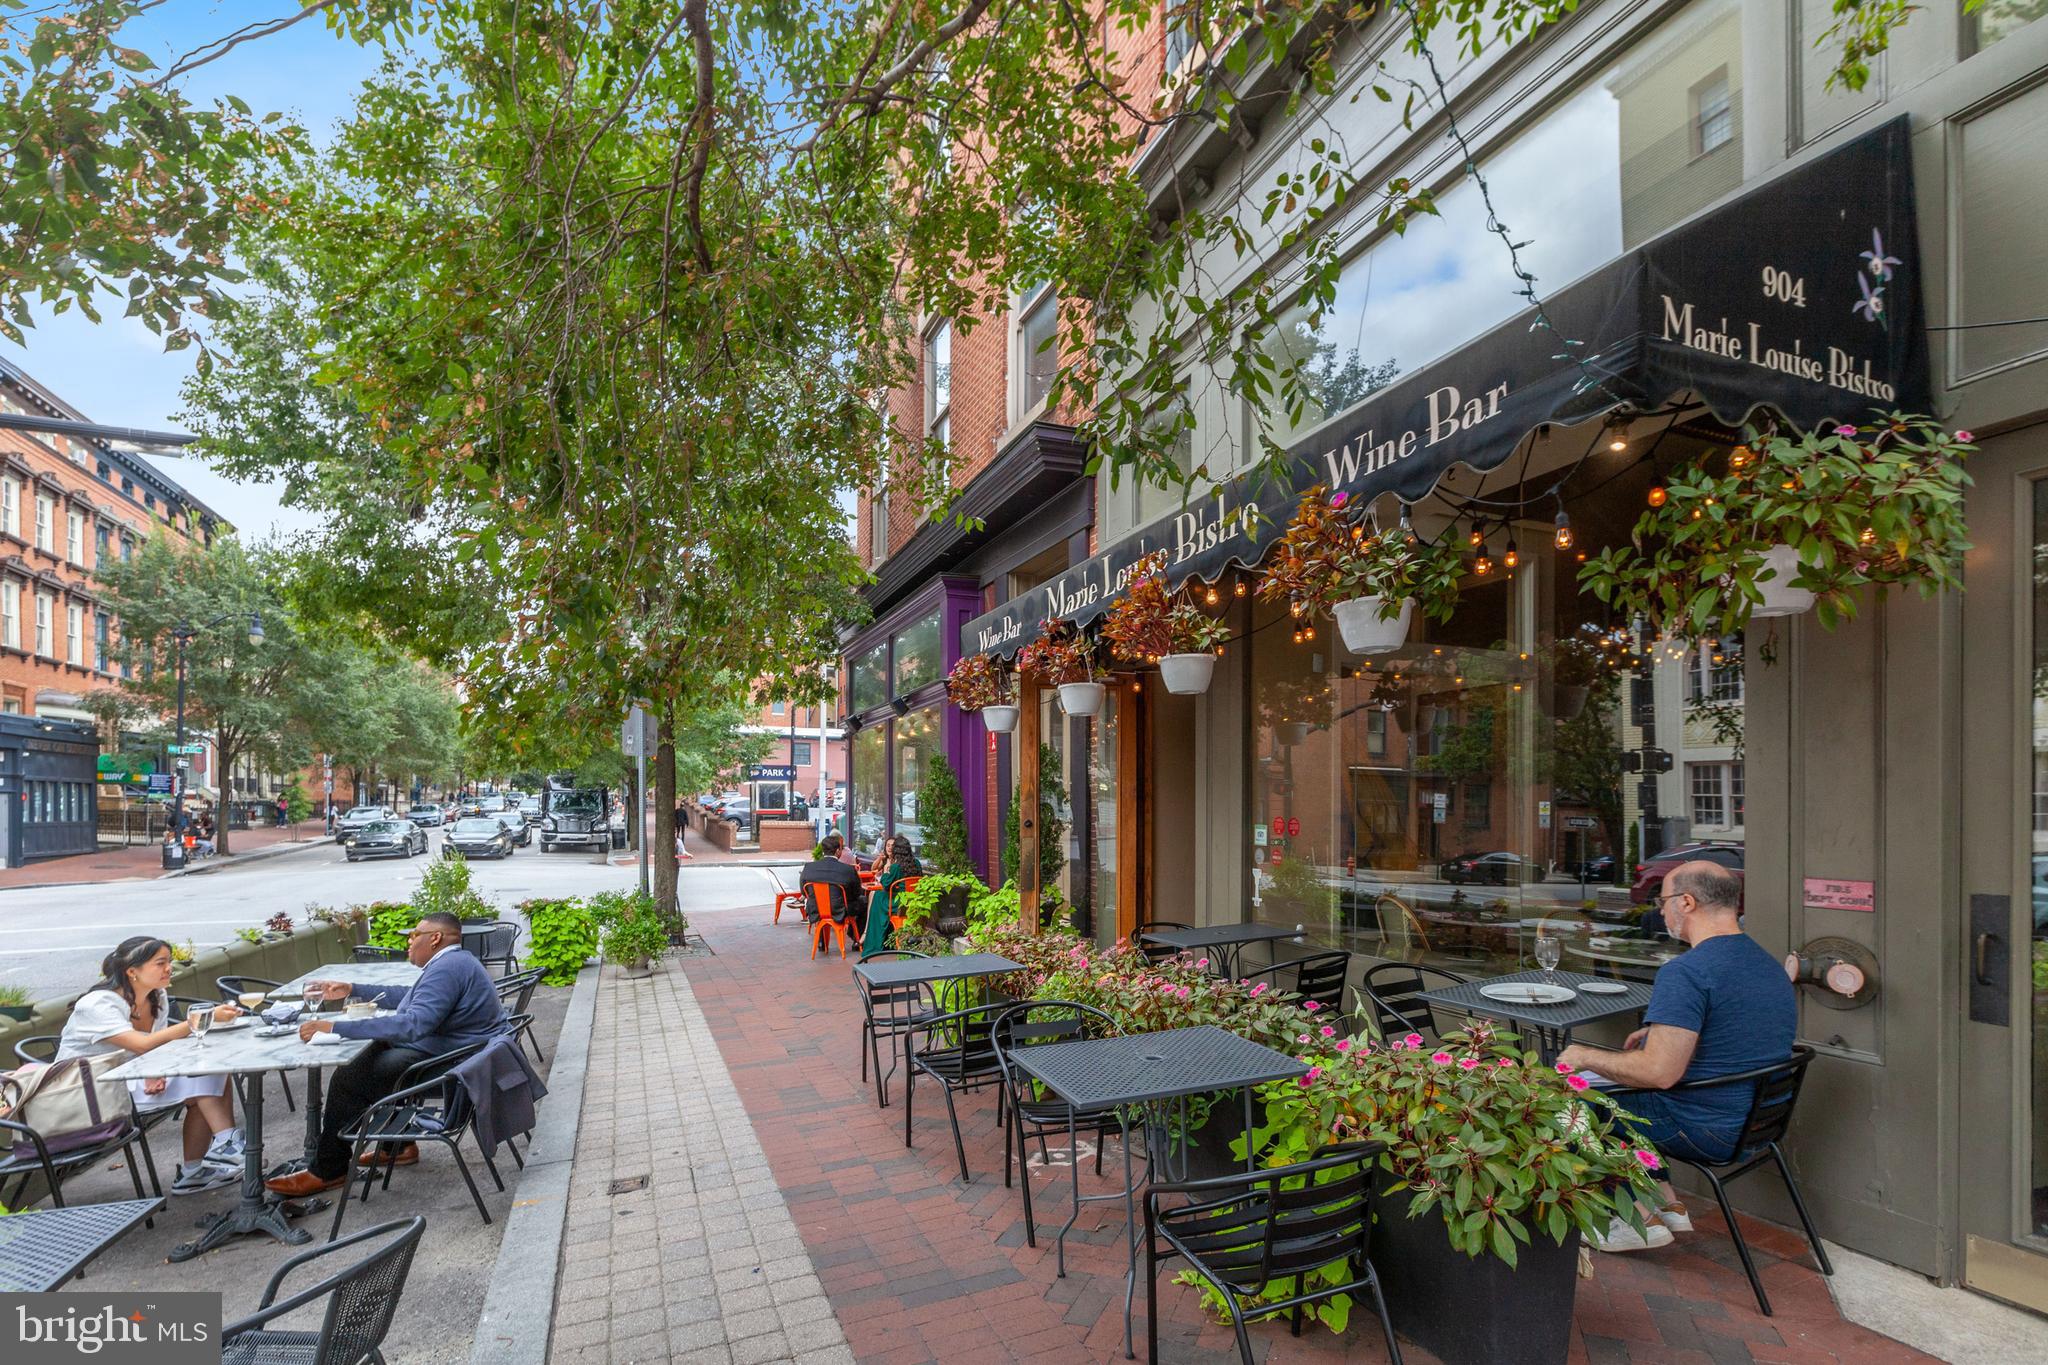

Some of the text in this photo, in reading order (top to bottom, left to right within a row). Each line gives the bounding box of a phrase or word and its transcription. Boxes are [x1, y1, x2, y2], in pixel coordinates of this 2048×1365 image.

[1762, 265, 1806, 308] 904
[1661, 294, 1896, 402] Marie Louise Bistro
[1323, 381, 1508, 490] Wine Bar
[1045, 570, 1098, 623] Marie
[979, 615, 1022, 652] Wine Bar
[762, 769, 784, 777] PARK
